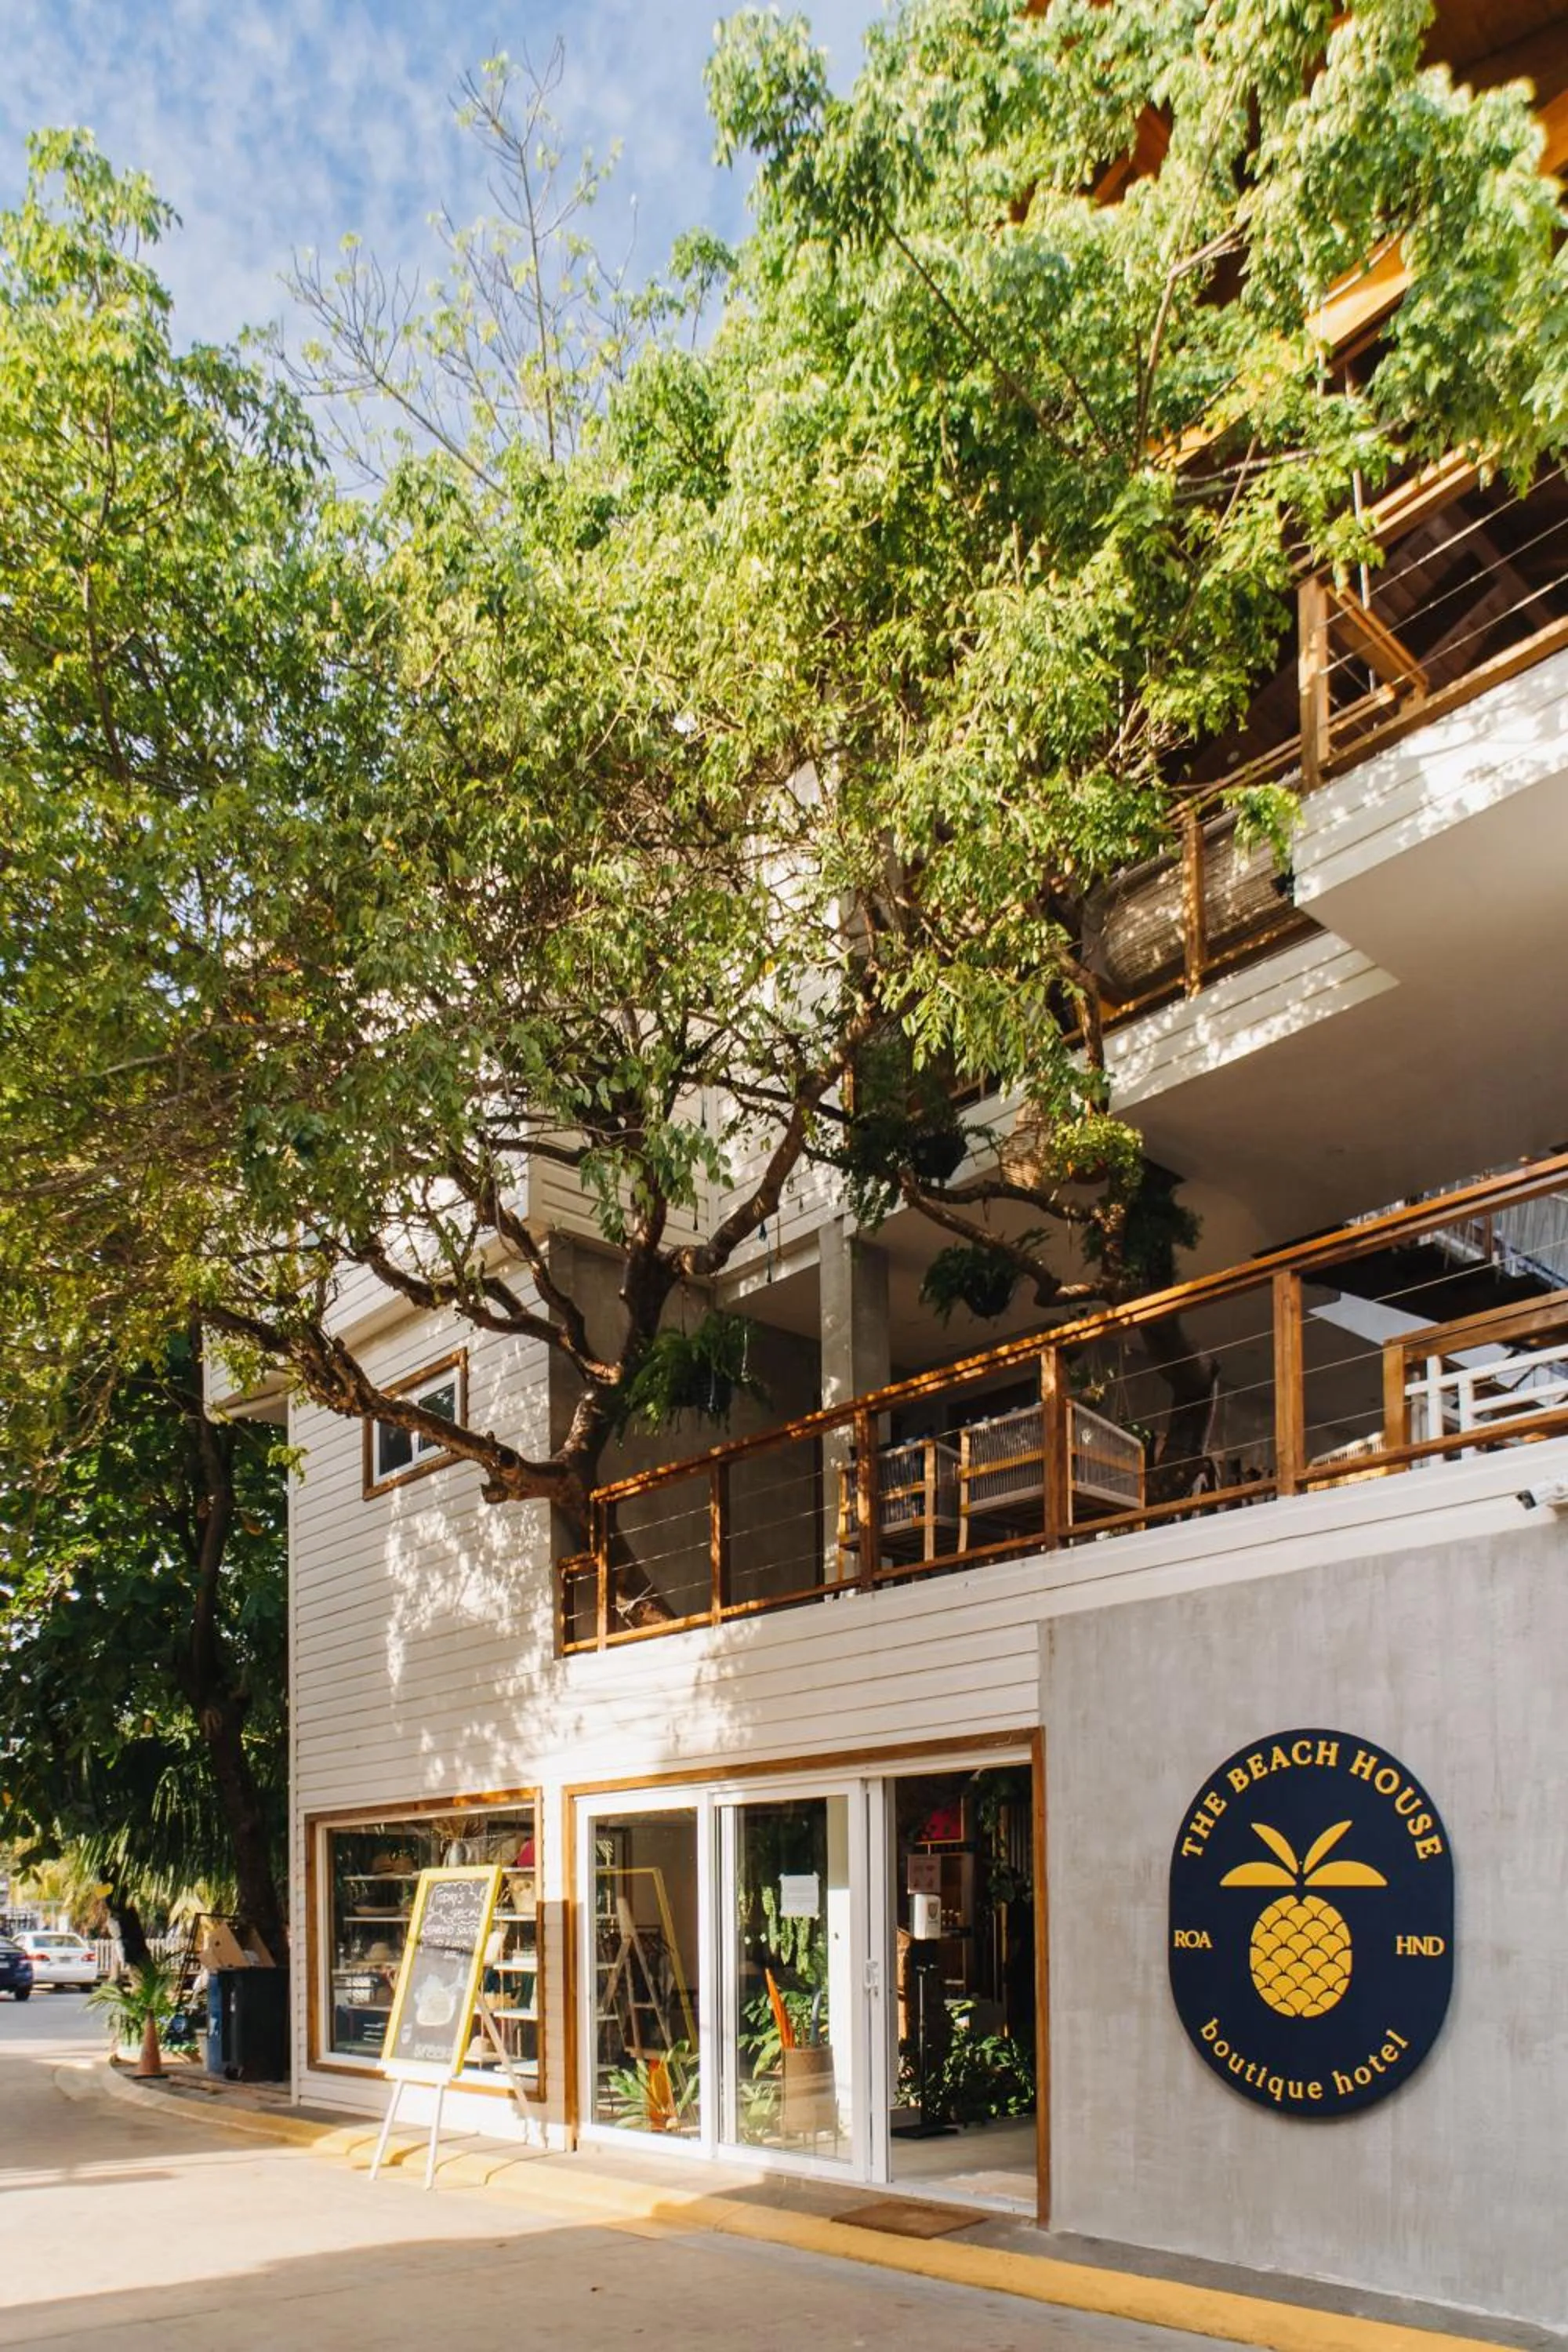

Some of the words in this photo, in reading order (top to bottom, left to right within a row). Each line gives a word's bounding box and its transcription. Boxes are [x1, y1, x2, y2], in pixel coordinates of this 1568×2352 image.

[1181, 1791, 1228, 1857] THE
[1228, 1740, 1339, 1793] BEACH
[1350, 1750, 1443, 1860] HOUSE
[1174, 1929, 1212, 1949] ROA
[1396, 1935, 1445, 1957] HND
[1201, 2018, 1323, 2102] boutique
[1332, 2029, 1409, 2095] hotel
